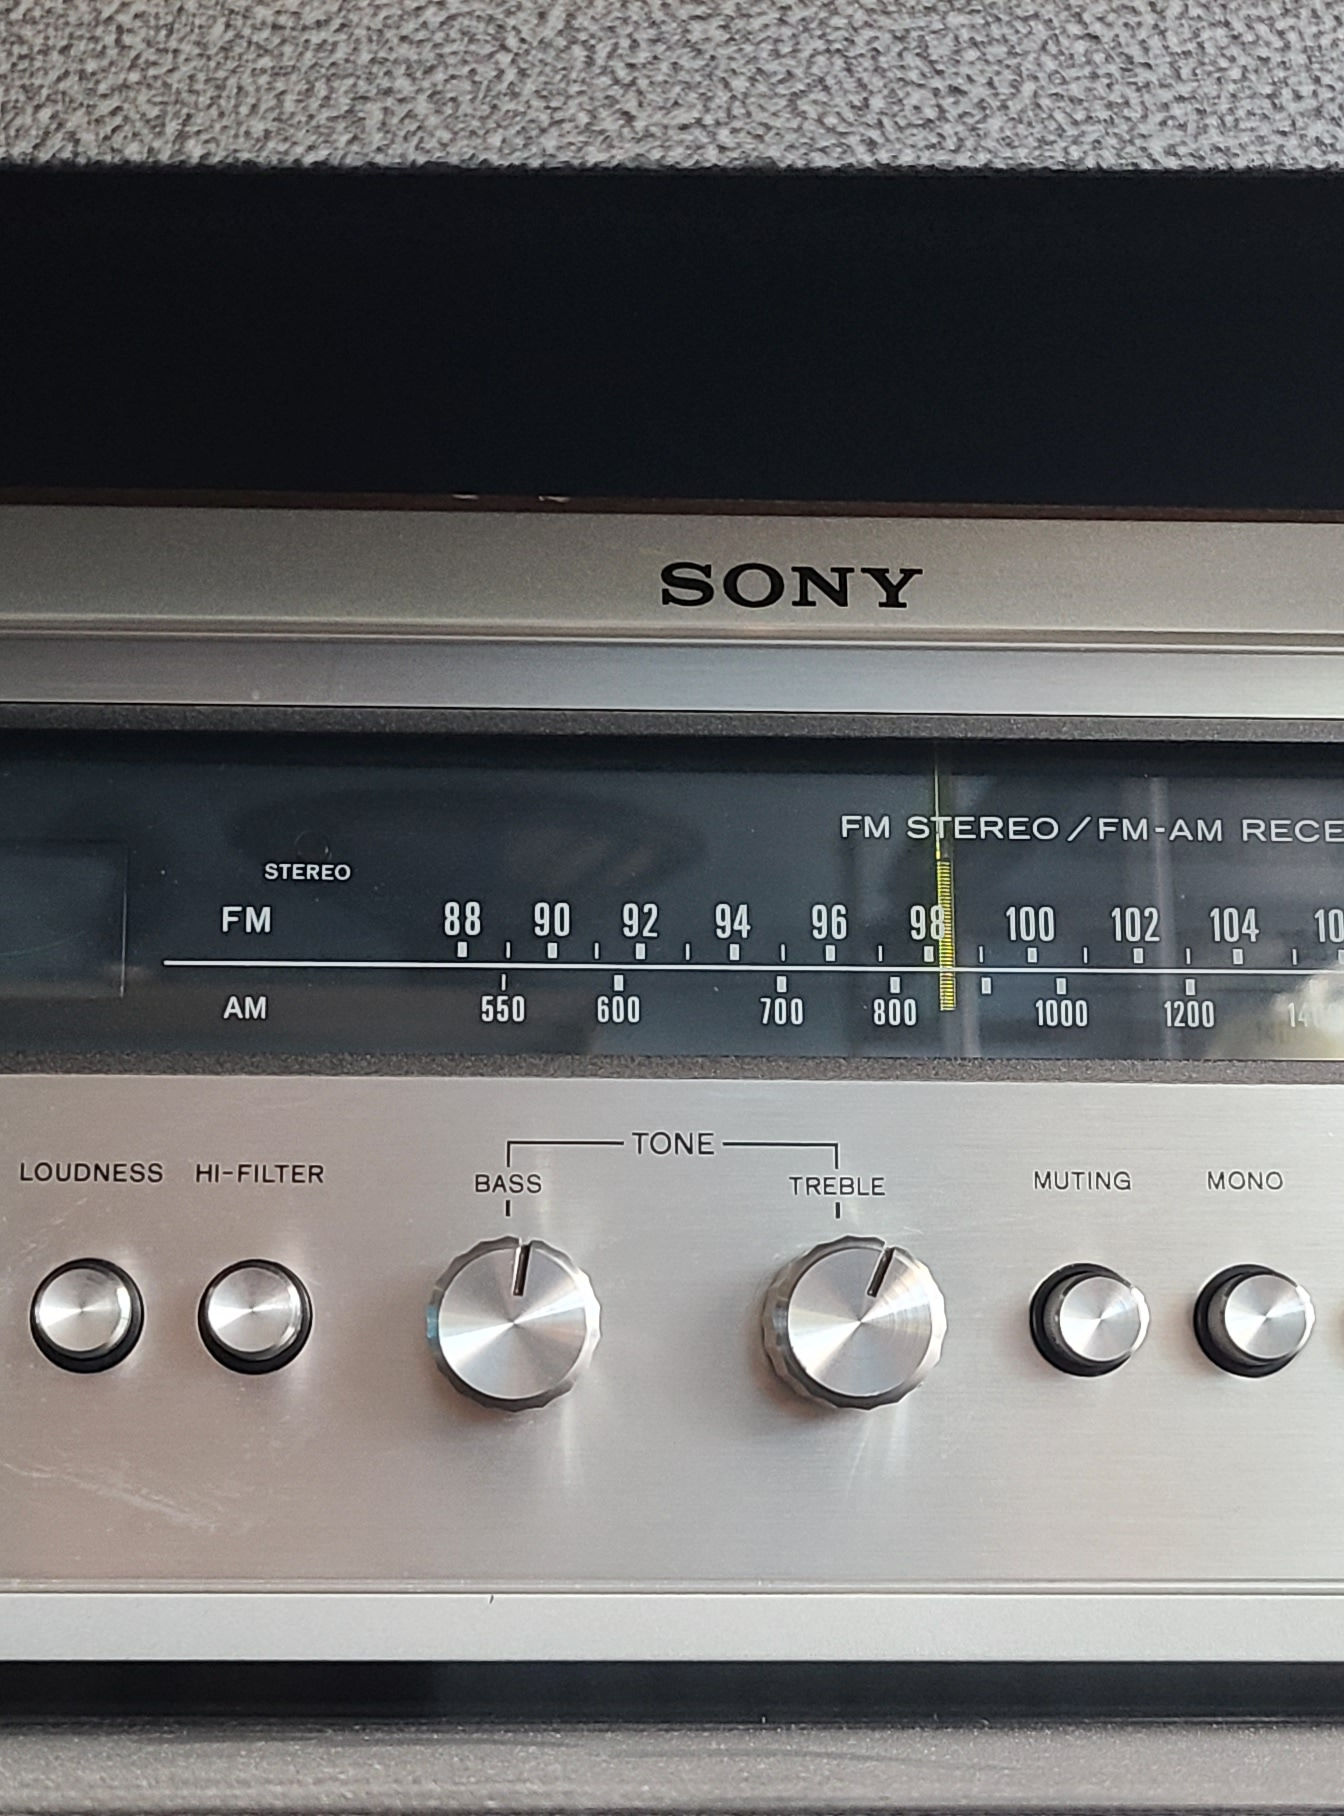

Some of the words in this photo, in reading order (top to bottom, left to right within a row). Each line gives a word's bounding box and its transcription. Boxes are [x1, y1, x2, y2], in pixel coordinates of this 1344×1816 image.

[660, 561, 924, 609] SONY
[841, 815, 890, 839] FM
[264, 863, 351, 881] STEREO
[222, 906, 271, 933] FM
[444, 901, 481, 936] 88
[534, 902, 570, 937] 90
[622, 903, 658, 938] 92
[715, 903, 751, 939] 94
[811, 904, 847, 940] 96
[910, 905, 945, 940] 98
[1006, 906, 1055, 942] 100
[1111, 907, 1161, 942] 102
[1210, 907, 1260, 943] 104
[223, 996, 267, 1019] AM
[481, 995, 525, 1022] 550
[597, 995, 640, 1023] 600
[760, 997, 803, 1025] 700
[873, 998, 917, 1026] 800
[1035, 999, 1088, 1027] 1000
[1164, 1000, 1215, 1028] 1200
[631, 1131, 715, 1155] TONE
[20, 1162, 163, 1183] LOUDNESS
[195, 1163, 324, 1184] HI-FILTER
[1034, 1170, 1131, 1191] MUTING
[1207, 1170, 1284, 1190] MONO
[475, 1173, 542, 1194] BASS
[788, 1176, 886, 1196] TREBLE
